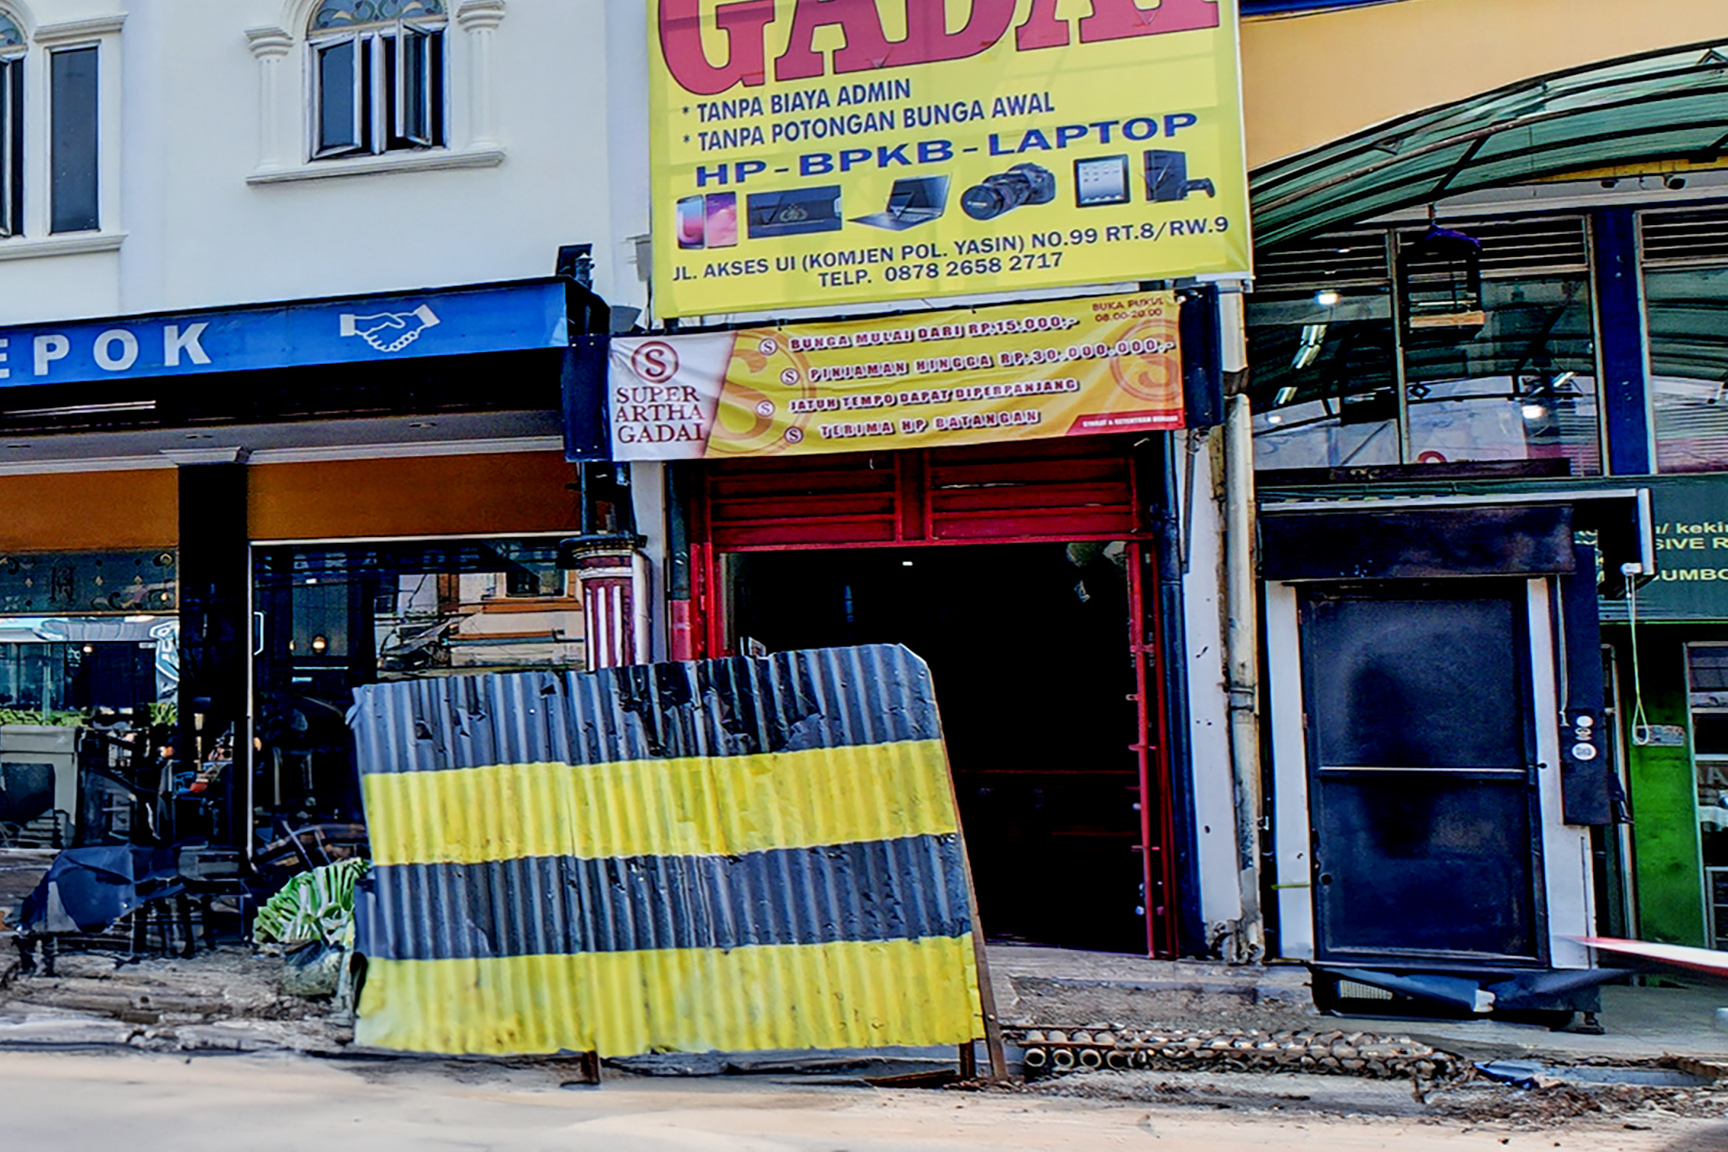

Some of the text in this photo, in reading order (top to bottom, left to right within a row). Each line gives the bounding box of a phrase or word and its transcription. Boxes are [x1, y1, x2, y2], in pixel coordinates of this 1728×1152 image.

[697, 78, 911, 123] TANPA BIAYA ADMIN
[698, 91, 1055, 152] TANPA POTONGAN BUNGA AWAL
[673, 216, 1229, 282] JL. AKSES UI (KOMJEN POL. YASIN) NO.99 RT.8/RW.9
[819, 252, 1063, 288] TELP. 0878 2658 2717
[1092, 301, 1125, 312] BUKA
[789, 332, 850, 351] BUNGA
[856, 328, 913, 346] MULAI
[917, 323, 963, 342] DARI
[809, 359, 908, 382] PINJAMAN
[915, 353, 993, 374] HINGGA
[616, 385, 701, 404] SUPER
[789, 397, 839, 414] JATUH
[842, 393, 896, 410] TEMPO
[899, 388, 951, 405] DAPAT
[615, 404, 705, 423] ARTHA
[819, 421, 893, 439] TERIMA
[901, 417, 928, 434] HP
[934, 410, 1041, 431] BATANGAN
[617, 423, 705, 445] GADAI
[1676, 521, 1728, 535] keki
[1654, 568, 1728, 581] UMBO
